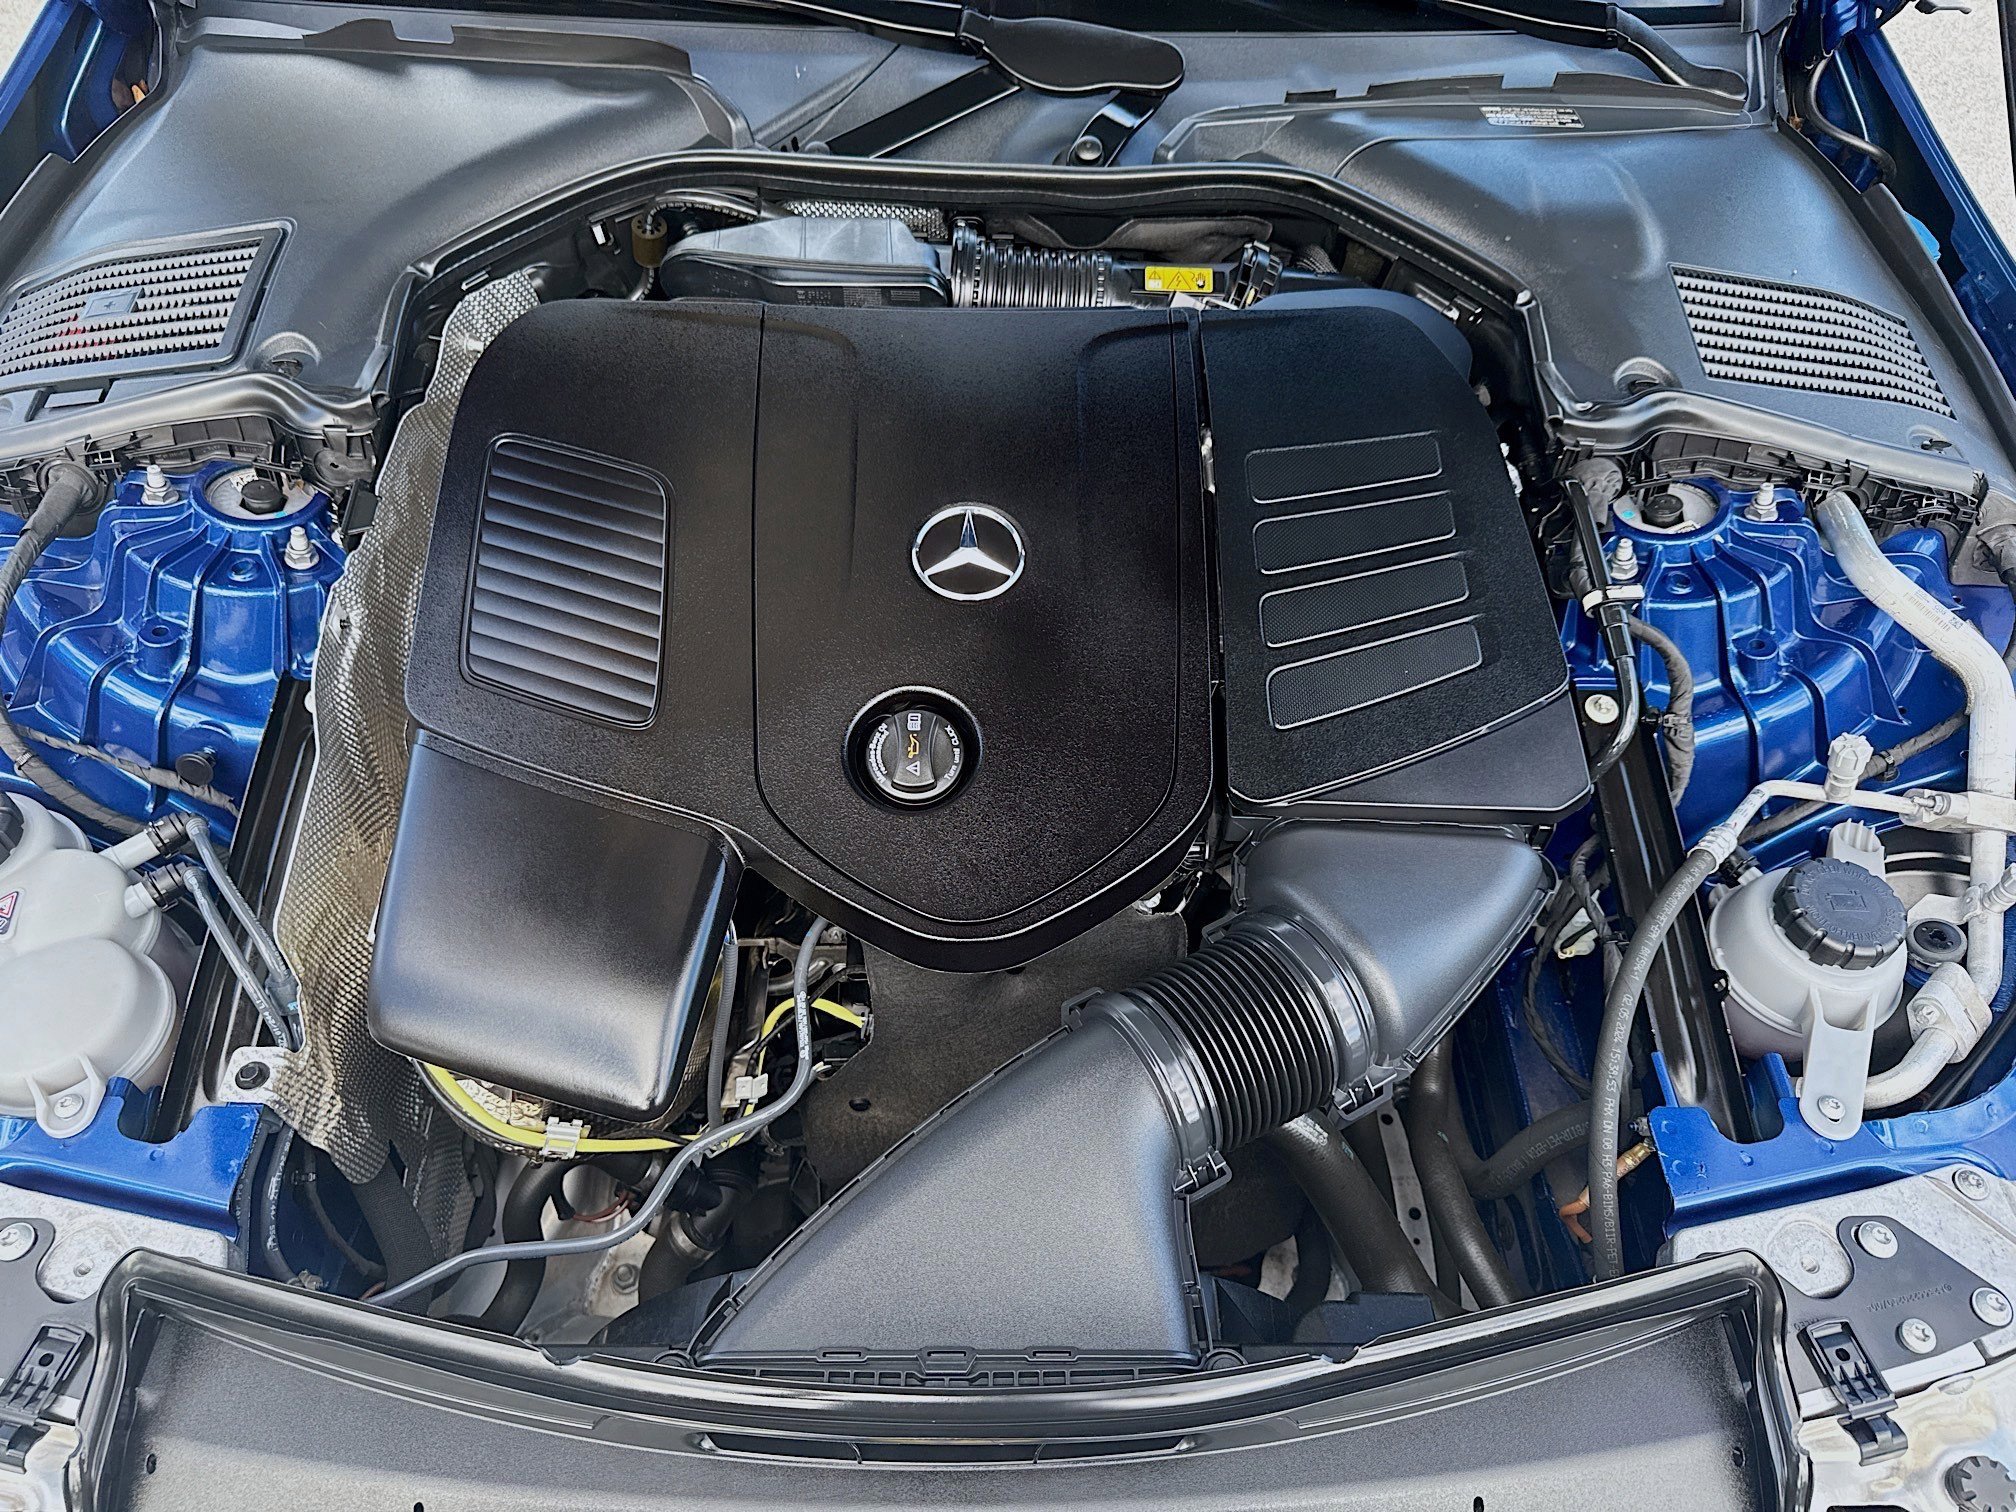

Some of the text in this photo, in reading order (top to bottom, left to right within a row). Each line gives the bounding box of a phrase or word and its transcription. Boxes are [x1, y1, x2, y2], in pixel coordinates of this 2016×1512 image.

[944, 725, 959, 745] CLICK
[869, 732, 886, 783] Mercedes-Benz
[944, 765, 957, 780] Turn
[1613, 993, 1634, 1043] 02.05.2024
[1606, 1048, 1621, 1092] 15:38:53
[1603, 1098, 1615, 1116] PHX
[1603, 1120, 1614, 1134] DN
[1602, 1137, 1613, 1150] 08
[1602, 1154, 1613, 1168] H3
